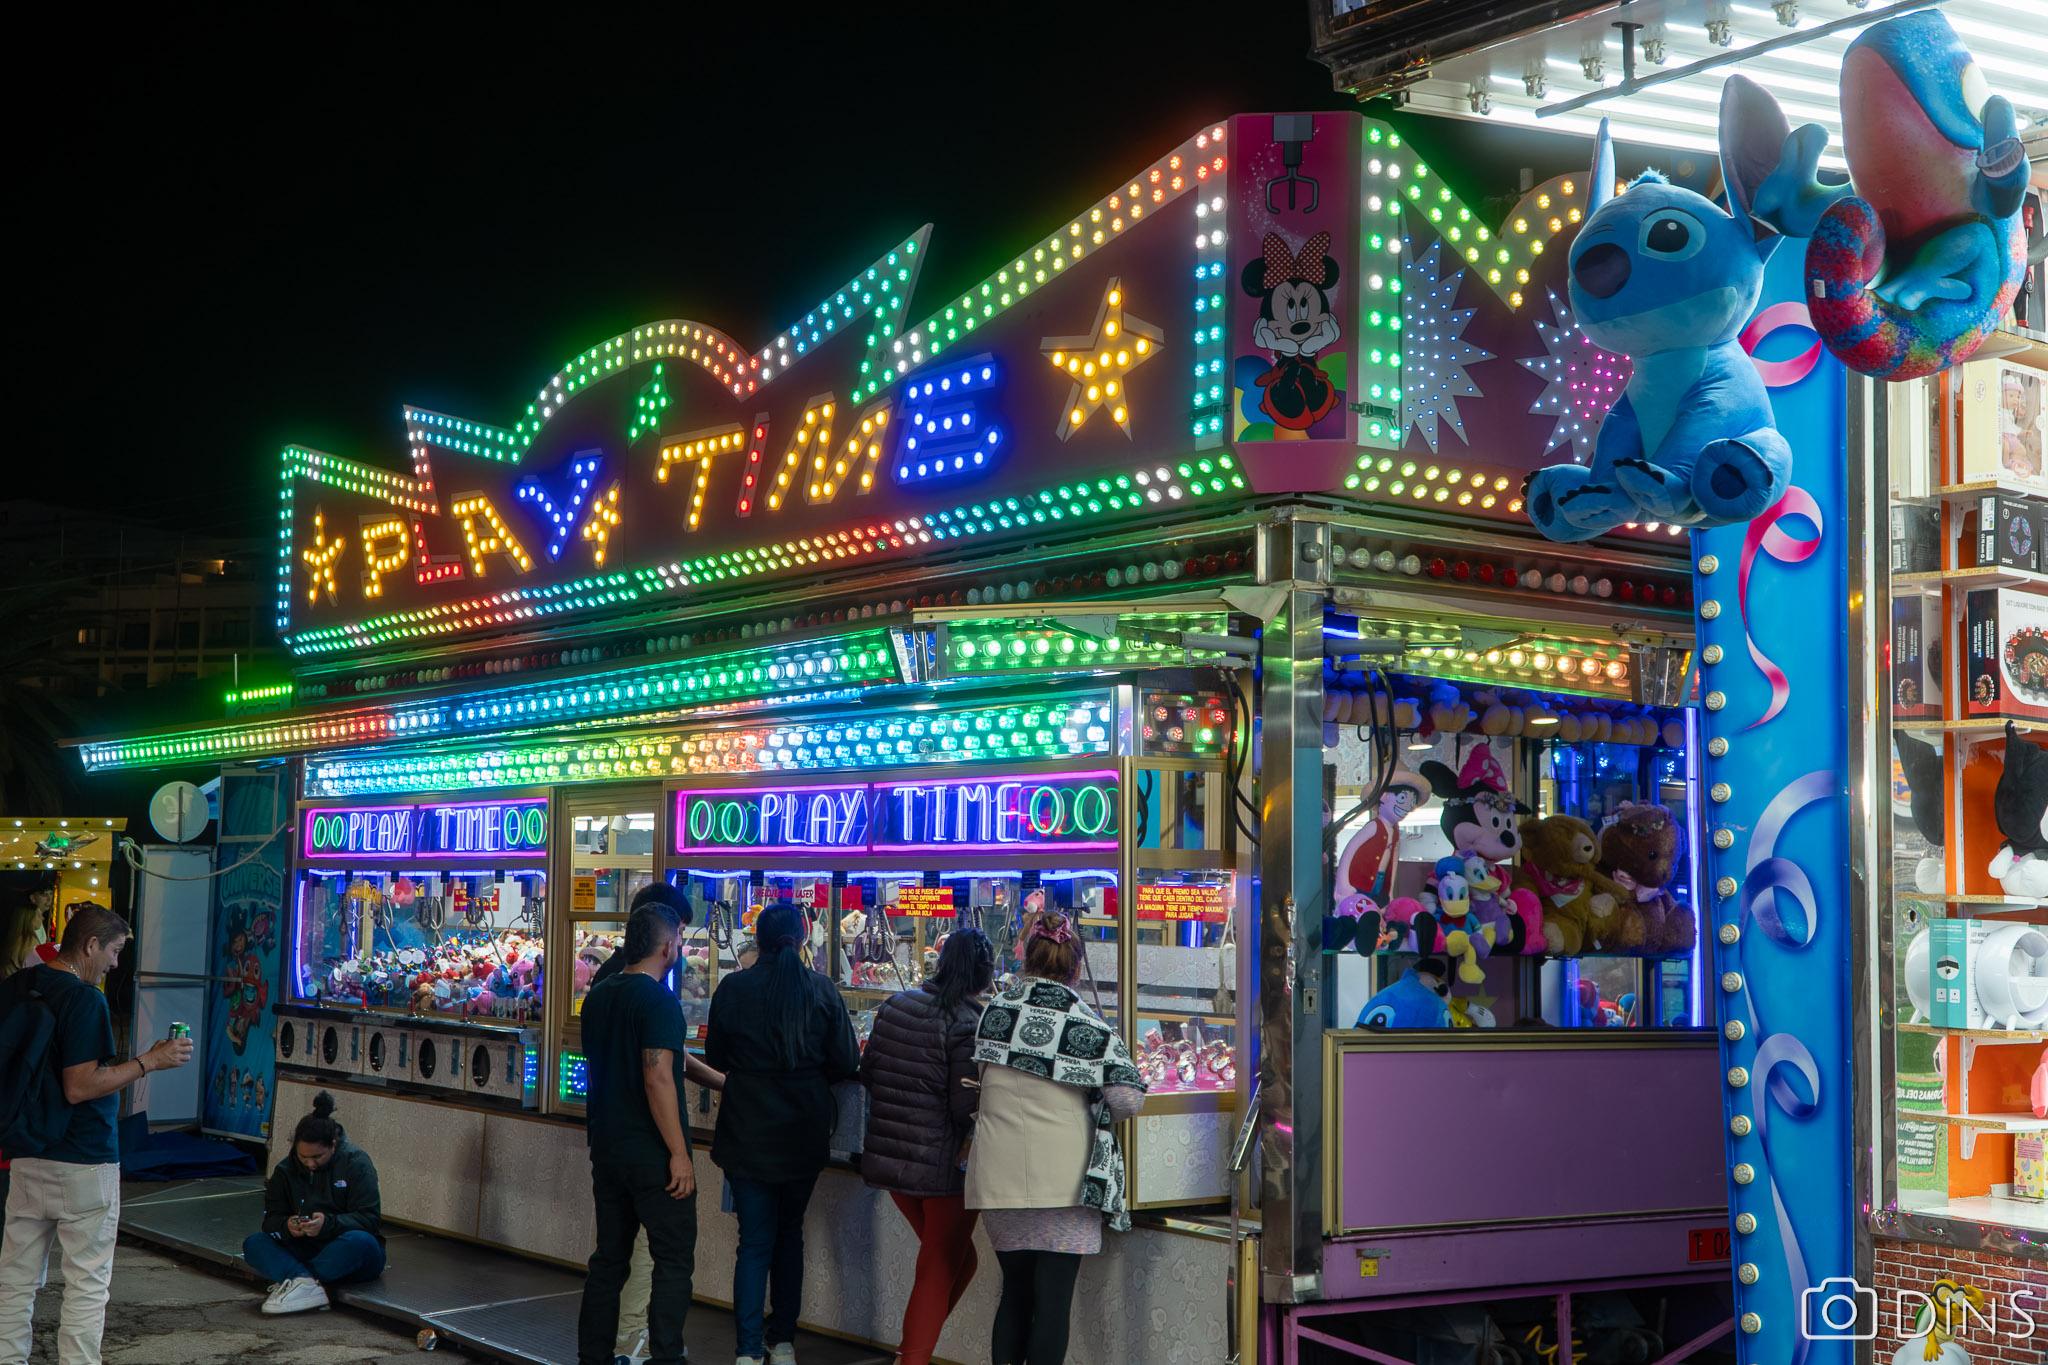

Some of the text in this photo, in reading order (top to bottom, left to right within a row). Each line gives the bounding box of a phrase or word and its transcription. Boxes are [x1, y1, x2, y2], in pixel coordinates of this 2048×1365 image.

[358, 352, 1004, 601] PLAY TIME
[349, 807, 501, 852] PLAY TIME
[759, 783, 1022, 843] PLAY TIME
